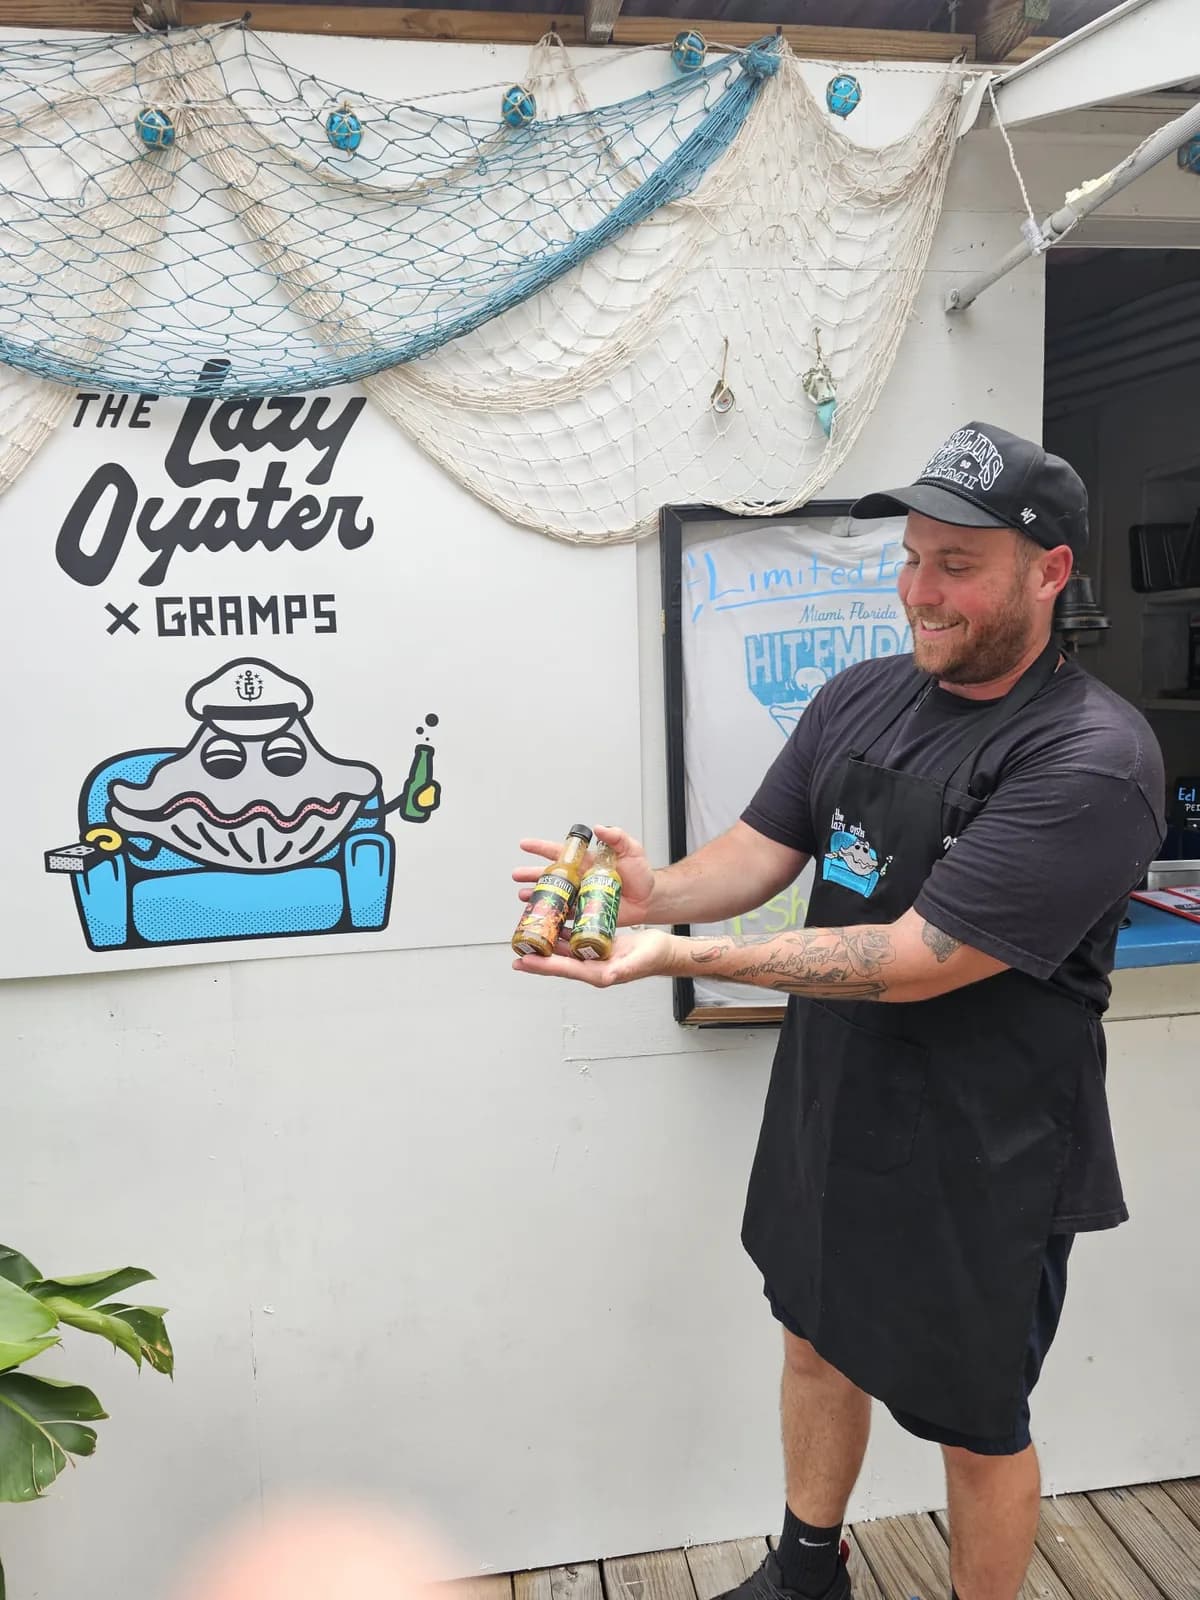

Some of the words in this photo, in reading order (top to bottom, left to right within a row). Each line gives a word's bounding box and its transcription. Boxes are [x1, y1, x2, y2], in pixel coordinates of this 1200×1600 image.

[72, 393, 159, 429] THE
[164, 358, 367, 488] Lazy
[922, 429, 1004, 492] RLINS
[55, 462, 374, 587] Oyster
[703, 550, 865, 602] Limited
[155, 594, 337, 637] GRAMPS
[849, 601, 898, 620] Florida
